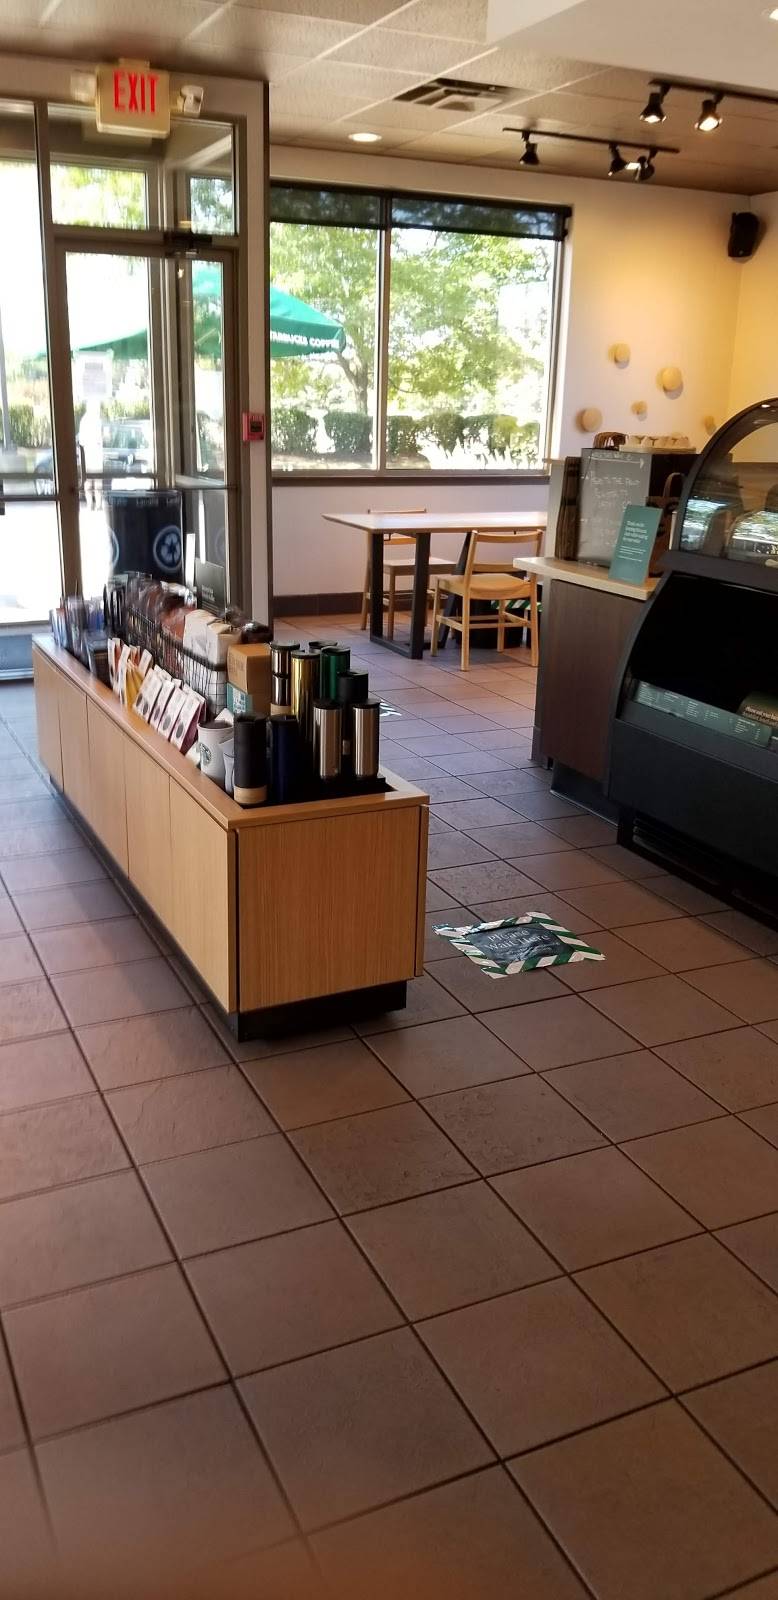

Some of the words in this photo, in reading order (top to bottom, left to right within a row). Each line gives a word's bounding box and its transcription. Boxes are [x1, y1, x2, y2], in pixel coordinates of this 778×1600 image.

[113, 71, 159, 114] EXIT
[485, 940, 519, 951] Wait
[519, 935, 550, 944] Here
[488, 930, 530, 942] Please
